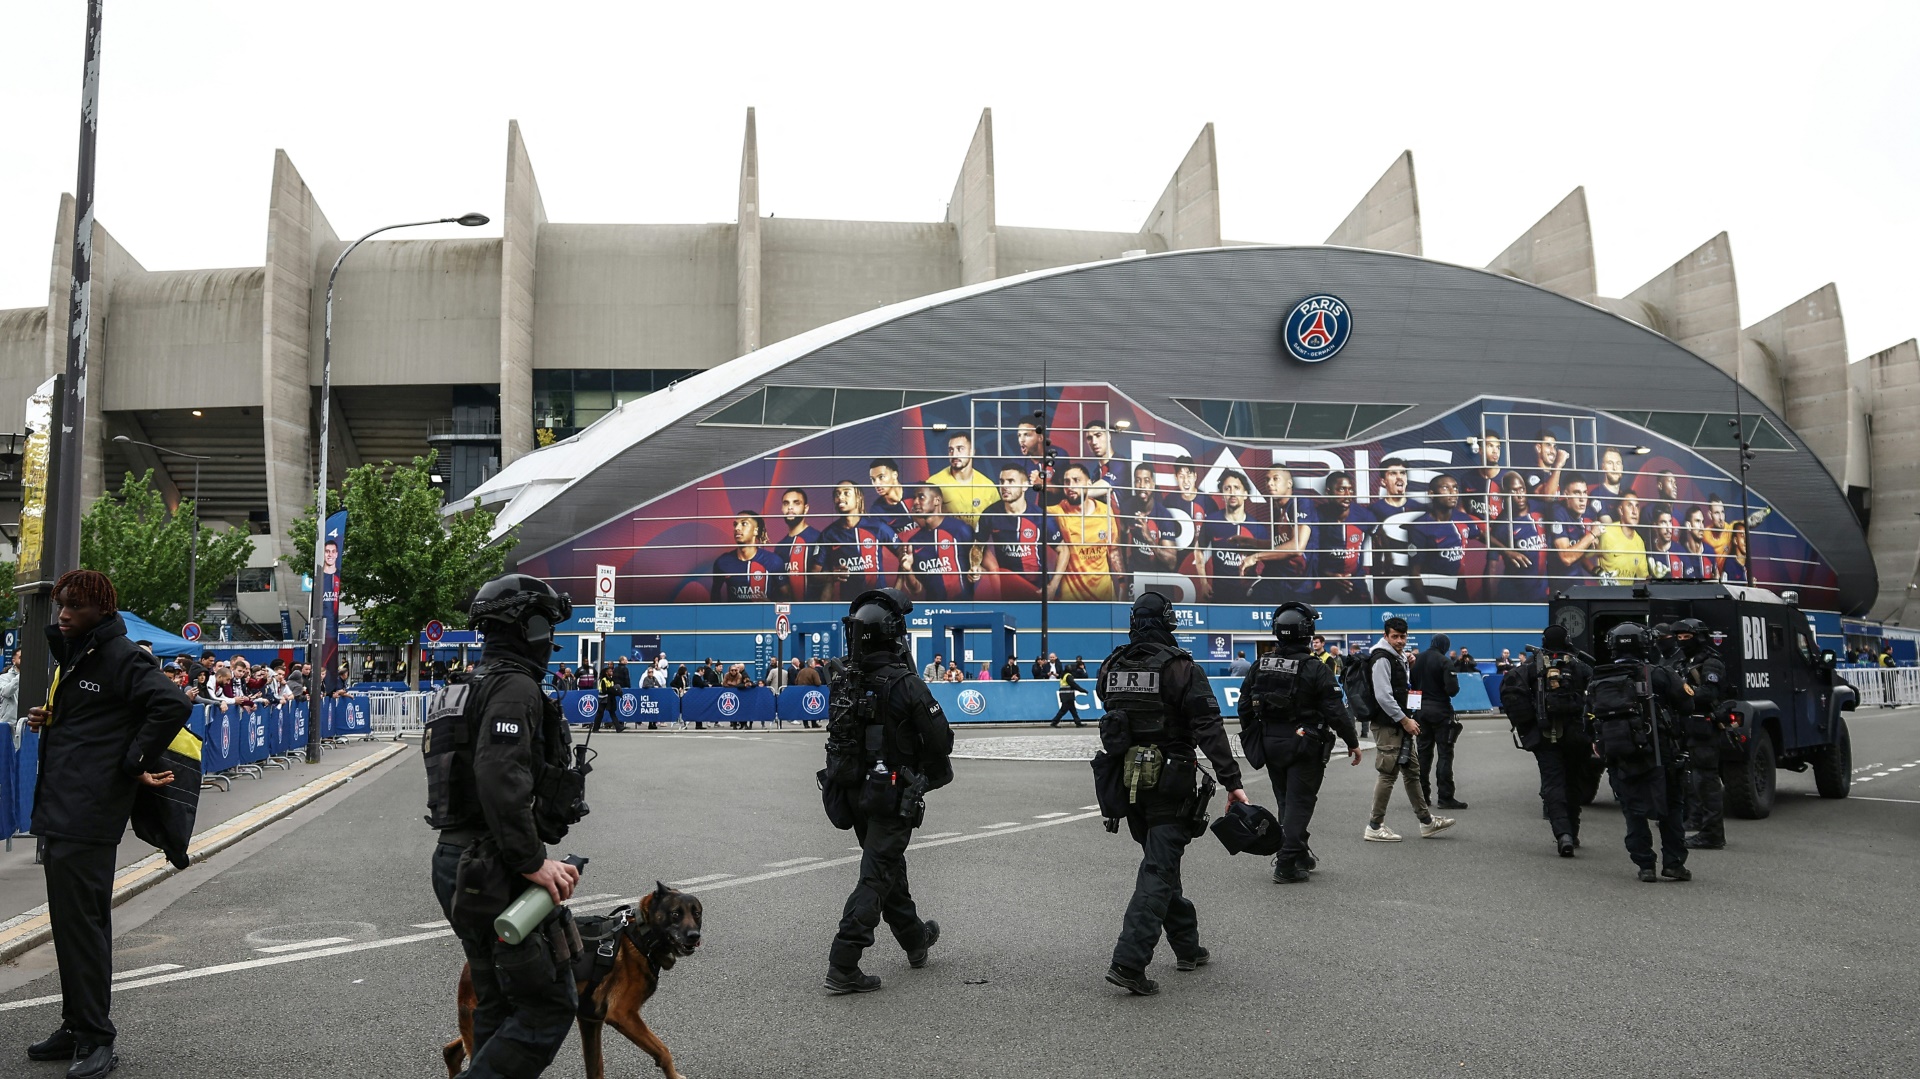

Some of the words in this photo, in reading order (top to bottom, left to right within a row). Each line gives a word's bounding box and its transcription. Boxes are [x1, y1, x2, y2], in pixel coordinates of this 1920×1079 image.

[1300, 299, 1343, 317] PARIS
[327, 527, 339, 538] 4
[838, 554, 873, 567] QATAR
[919, 556, 951, 571] QATAR
[912, 618, 928, 626] DES
[1195, 611, 1205, 625] L
[1742, 615, 1769, 660] BRI
[1745, 672, 1770, 689] POLICE
[495, 721, 519, 734] 1K9
